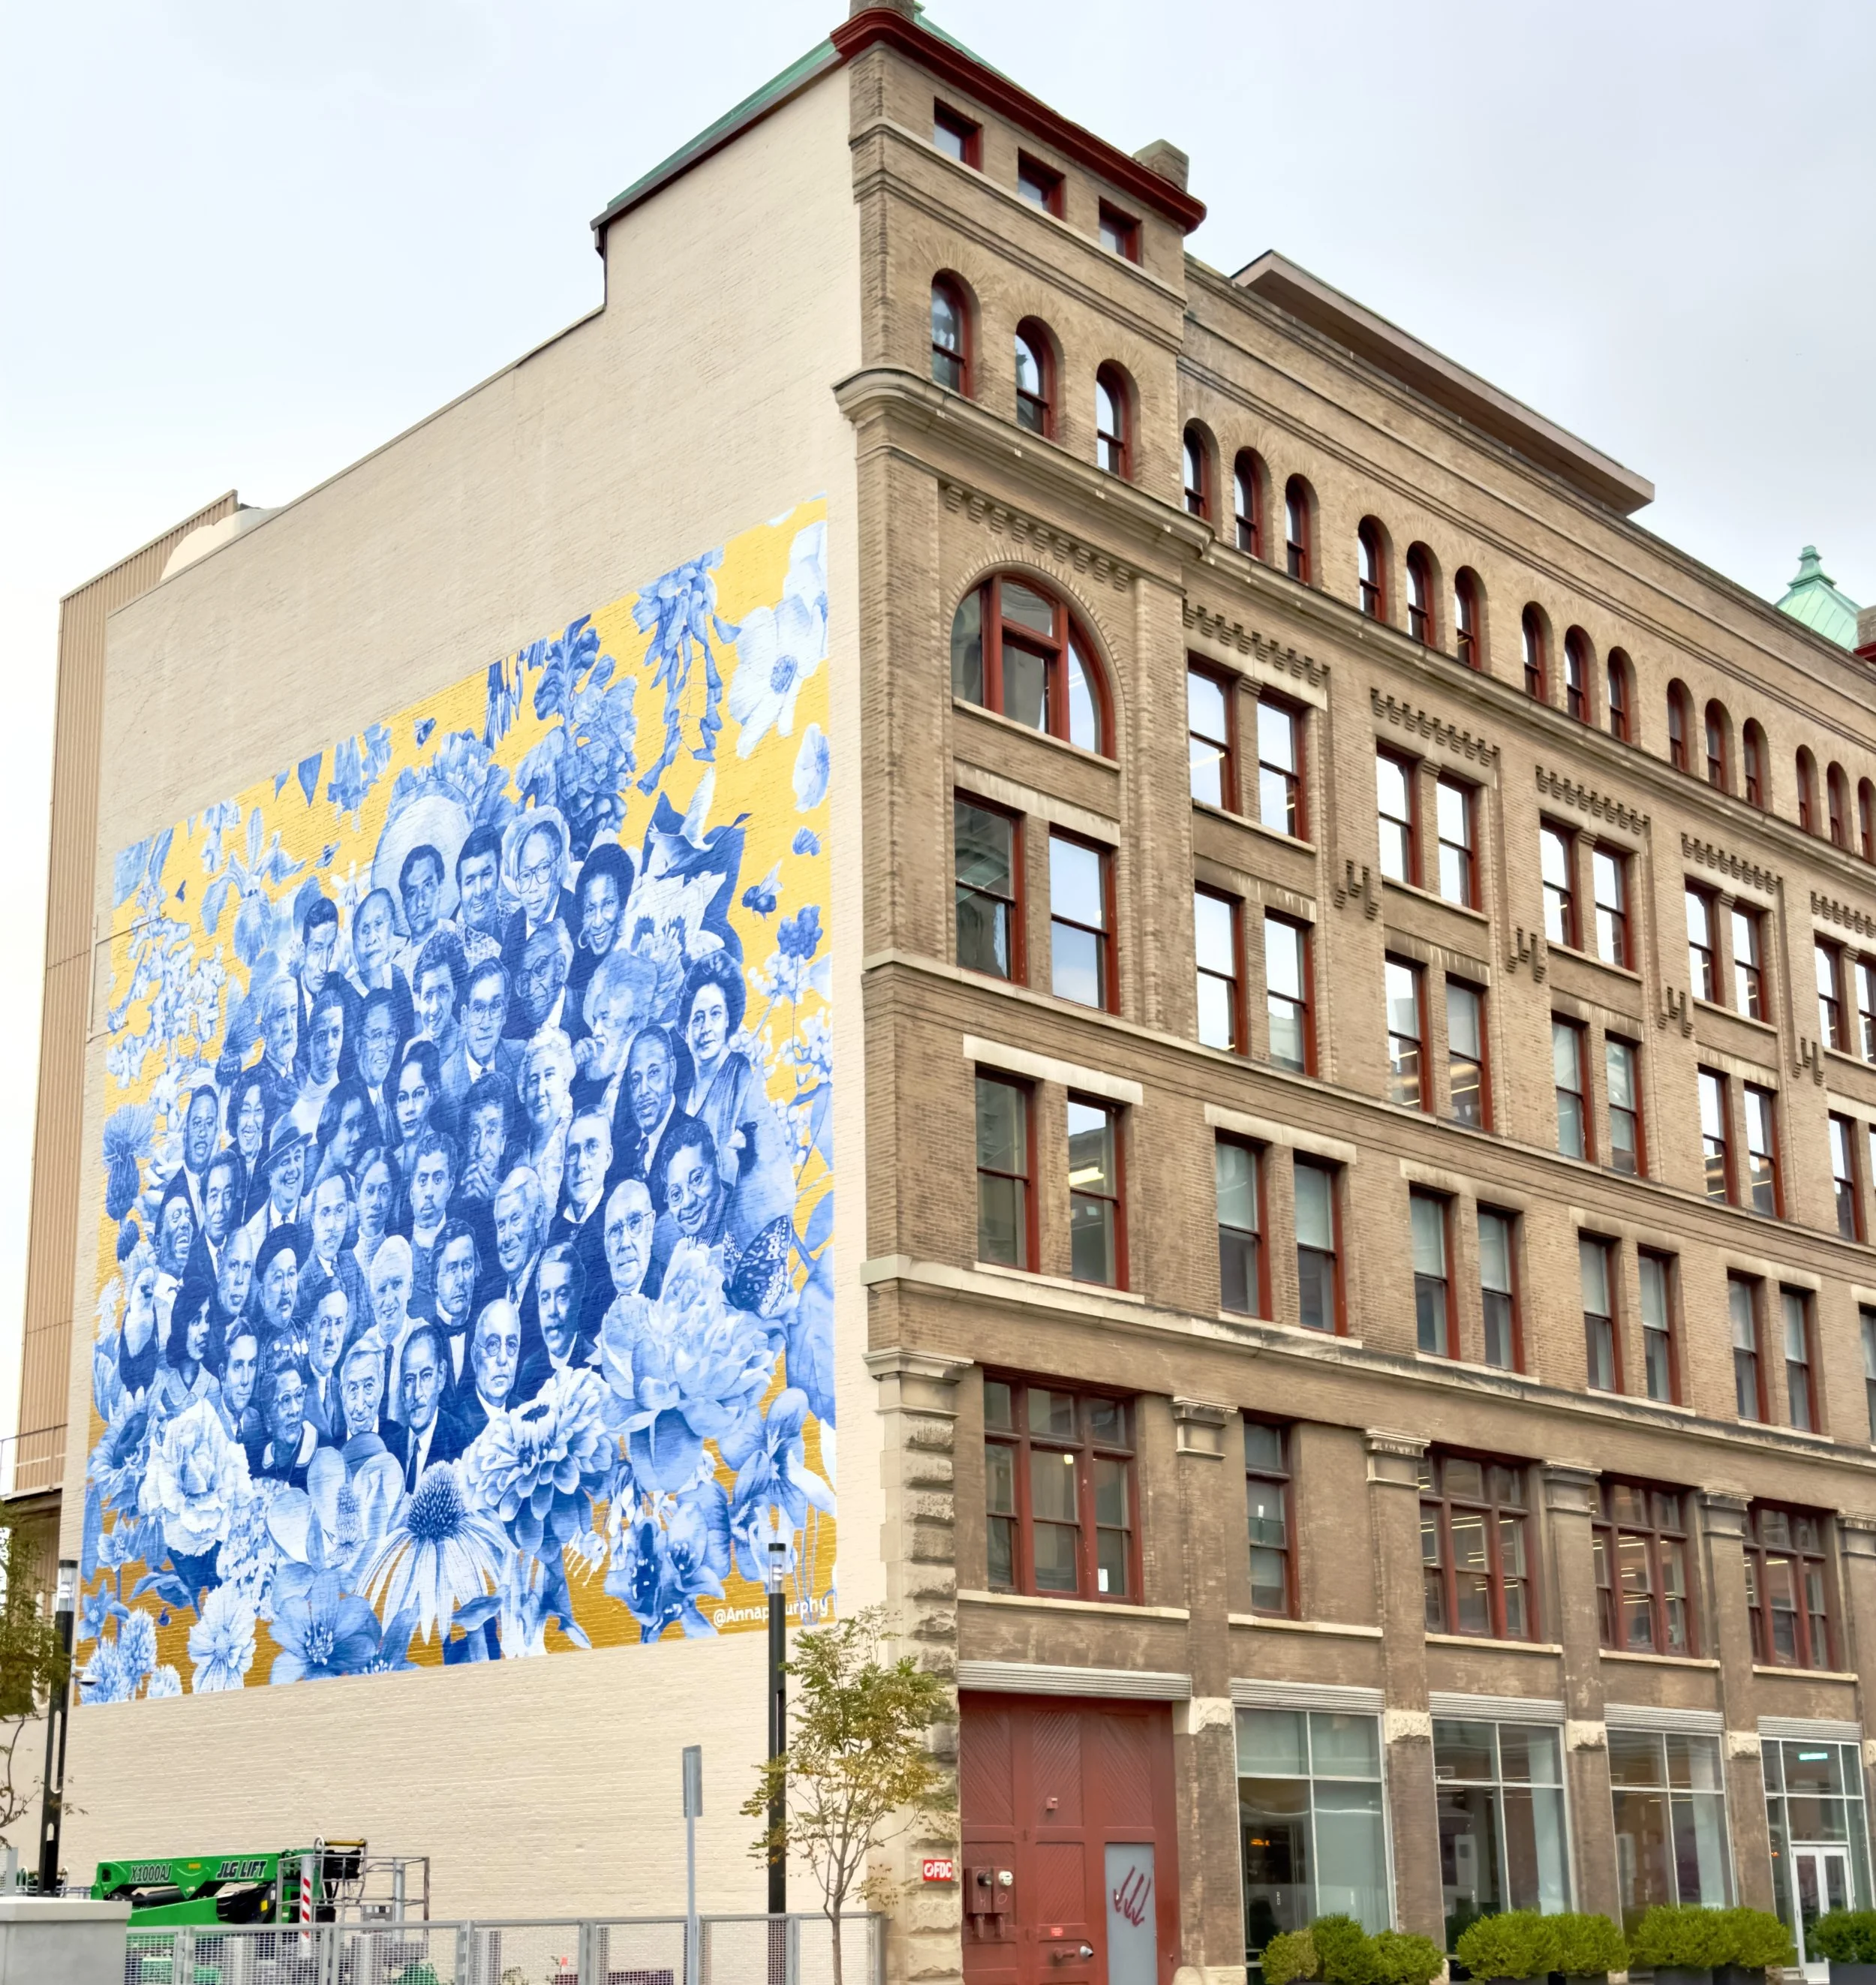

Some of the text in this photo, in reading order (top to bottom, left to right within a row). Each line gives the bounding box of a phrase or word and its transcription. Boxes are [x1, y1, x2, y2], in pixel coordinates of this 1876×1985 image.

[714, 1596, 828, 1627] @Annapurphy
[130, 1864, 172, 1883] X1000AJ
[216, 1860, 268, 1879] JLG LIFT
